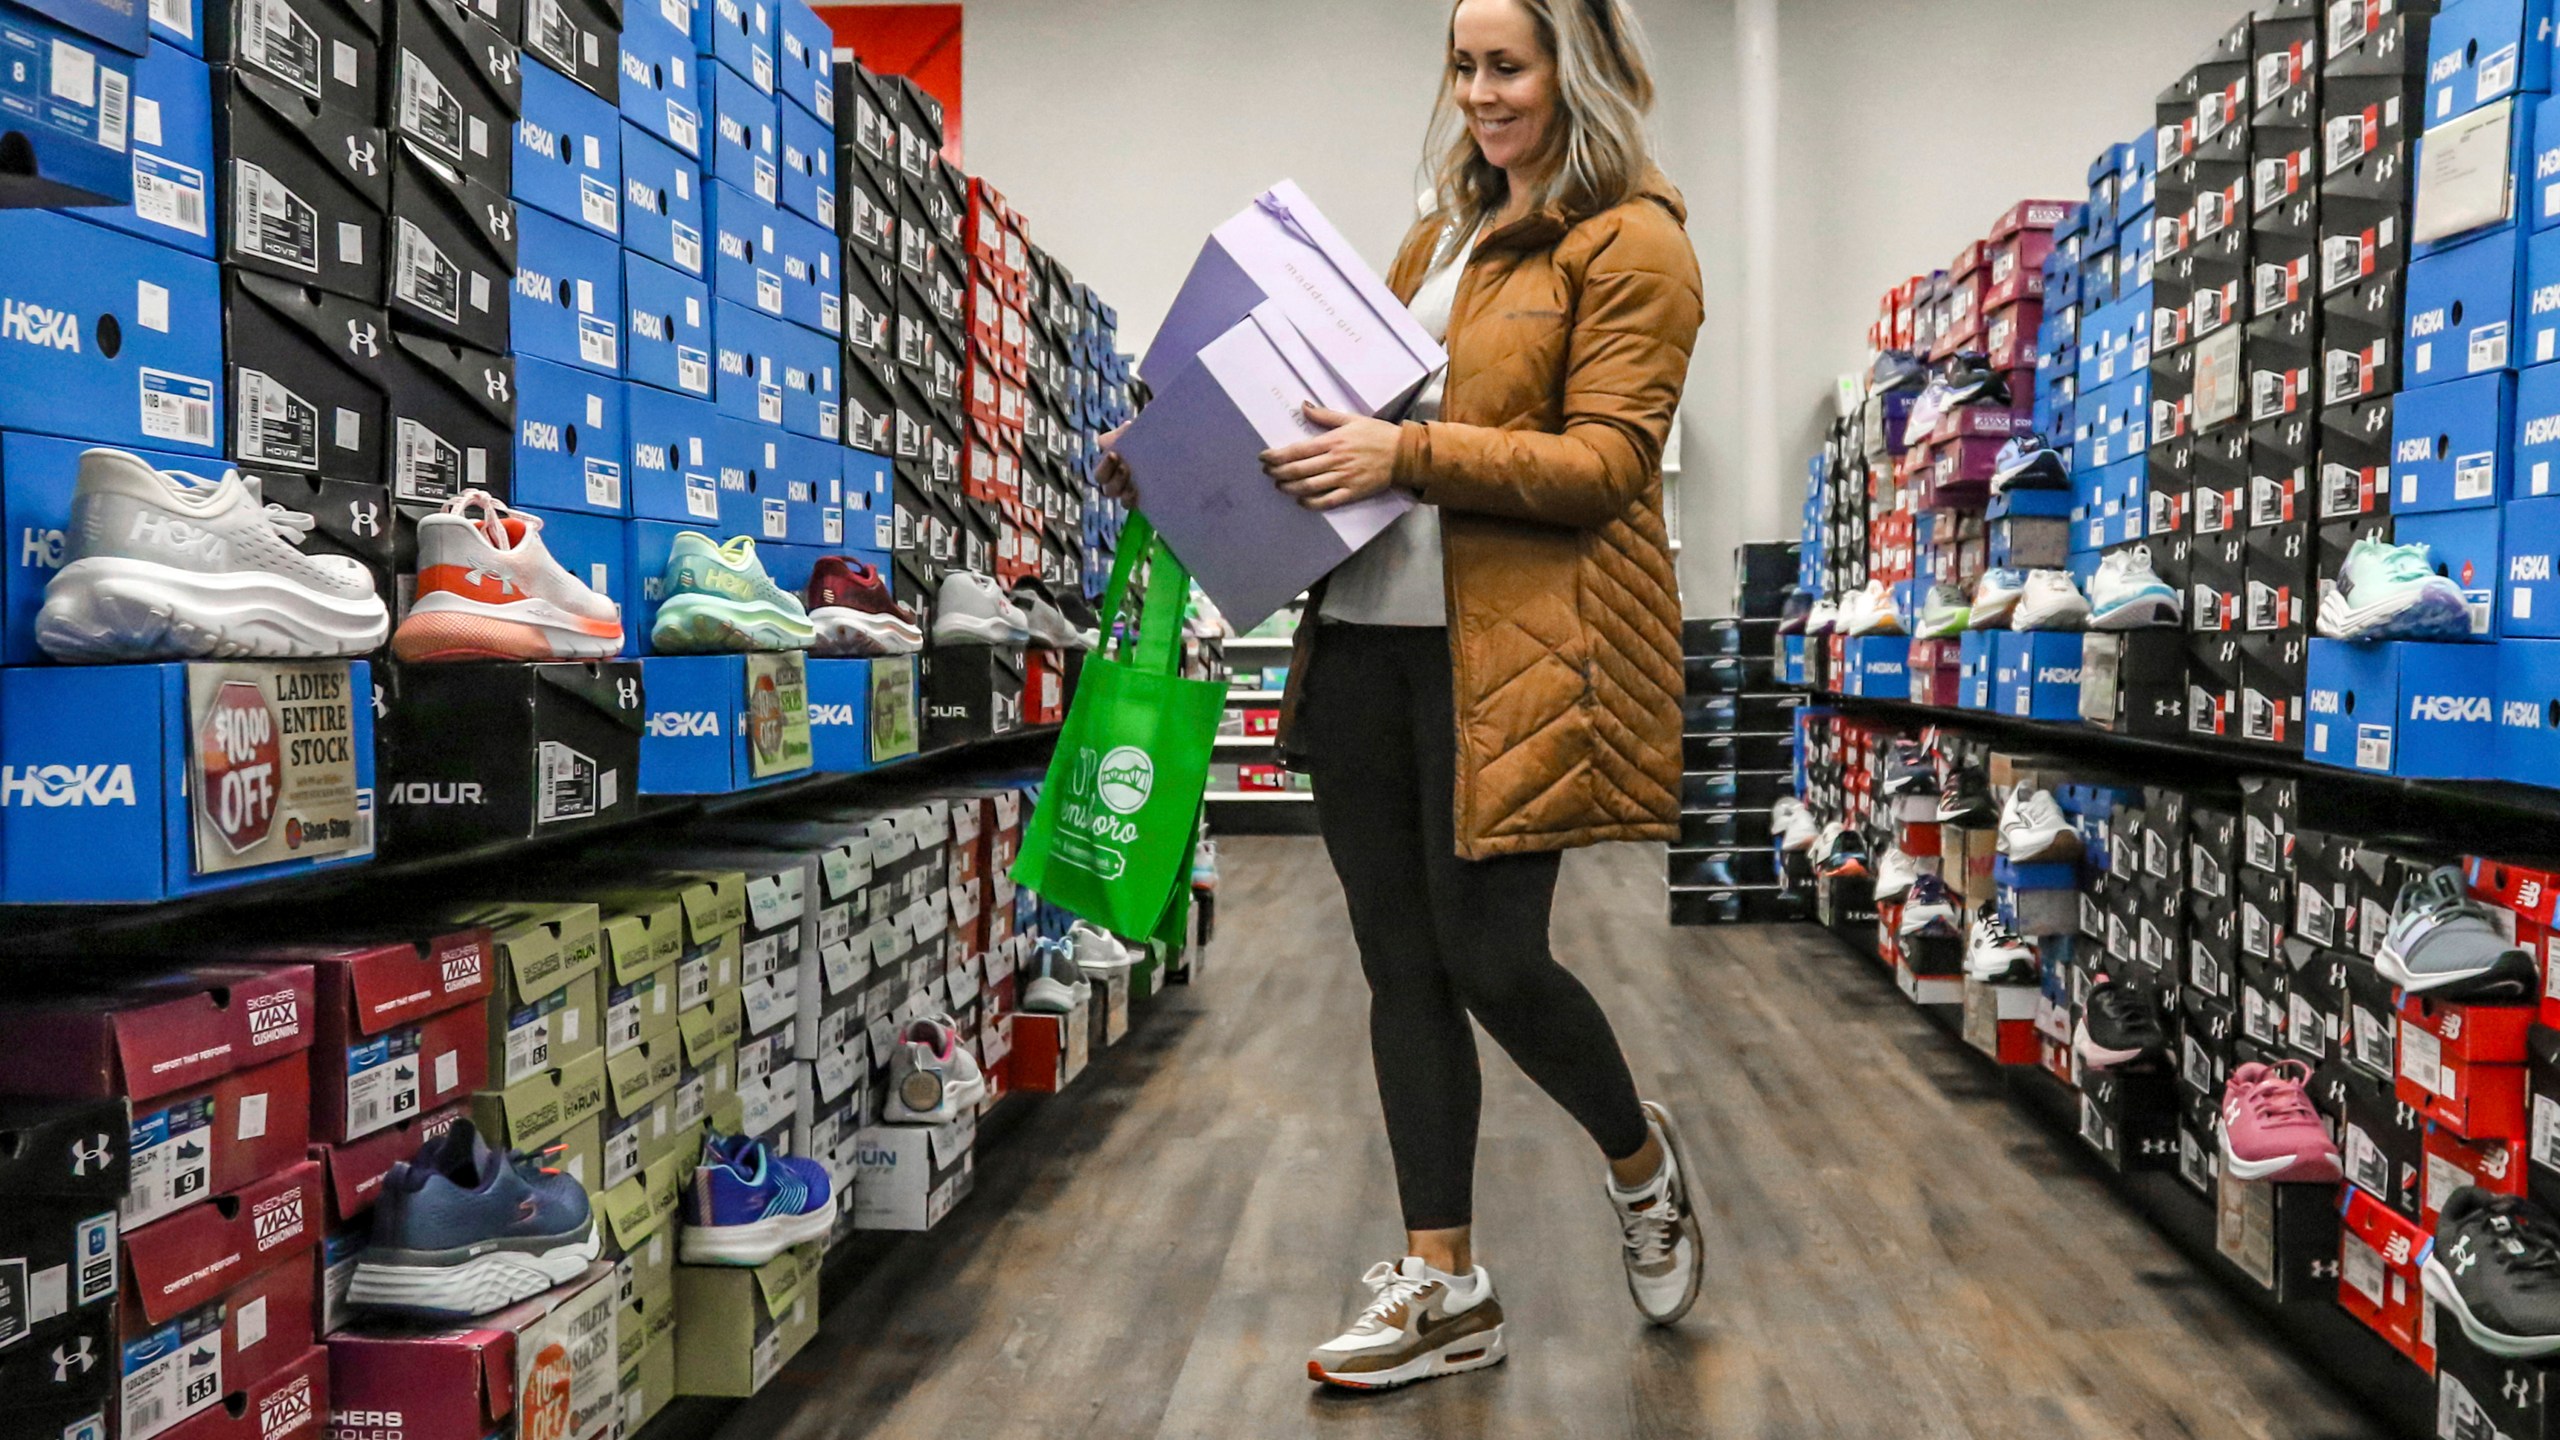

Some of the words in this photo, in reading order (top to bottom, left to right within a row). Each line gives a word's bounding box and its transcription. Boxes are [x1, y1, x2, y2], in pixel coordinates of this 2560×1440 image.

[13, 61, 25, 82] 8
[268, 56, 301, 79] HOVR
[622, 50, 651, 89] HOKA
[2431, 49, 2463, 84] HOKA
[519, 117, 555, 160] HOKA
[720, 113, 742, 146] HOKA
[628, 178, 657, 214] HOKA
[264, 242, 298, 258] HOVR
[719, 230, 743, 260] HOKA
[785, 255, 806, 281] HOKA
[516, 267, 553, 304] HOKA
[1285, 262, 1335, 316] madden
[1336, 318, 1362, 343] girl
[2, 298, 81, 354] HOKA
[633, 309, 662, 341] HOKA
[2411, 308, 2444, 338] HOKA
[719, 349, 743, 376] HOKA
[785, 367, 806, 391] HOKA
[522, 420, 559, 452] HOKA
[2397, 437, 2431, 463] HOKA
[265, 446, 298, 458] HOVR
[636, 443, 665, 471] HOKA
[417, 486, 445, 495] HOVR
[720, 467, 745, 491] HOKA
[788, 481, 808, 502] HOKA
[2510, 555, 2550, 580] HOKA
[1866, 662, 1903, 674] HOKA
[275, 673, 346, 701] LADIES'
[2310, 689, 2339, 714] HOKA
[2409, 695, 2493, 722] HOKA
[2502, 701, 2541, 728] HOKA
[281, 705, 347, 734] ENTIRE
[645, 711, 720, 737] HOKA
[291, 736, 350, 766] STOCK
[1, 764, 136, 807] HOKA
[220, 762, 274, 834] OFF
[443, 954, 481, 981] MAX
[246, 988, 296, 1010] SKECHERS
[253, 1003, 297, 1032] MAX
[252, 1022, 299, 1046] CUSHIONING
[152, 1057, 183, 1074] COMFORT
[184, 1052, 200, 1064] THAT
[400, 1092, 409, 1110] 5
[515, 1101, 558, 1130] SKECHERS
[183, 1173, 196, 1192] 9
[252, 1186, 301, 1217] SKECHERS
[258, 1200, 302, 1238] MAX
[257, 1222, 303, 1252] CUSHIONING
[163, 1271, 194, 1295] COMFORT
[194, 1266, 210, 1281] THAT
[209, 1253, 241, 1274] PERFORMS
[191, 1376, 212, 1402] 5.5
[259, 1374, 309, 1411] SKECHERS
[264, 1388, 309, 1434] MAX
[330, 1410, 403, 1427] HERS
